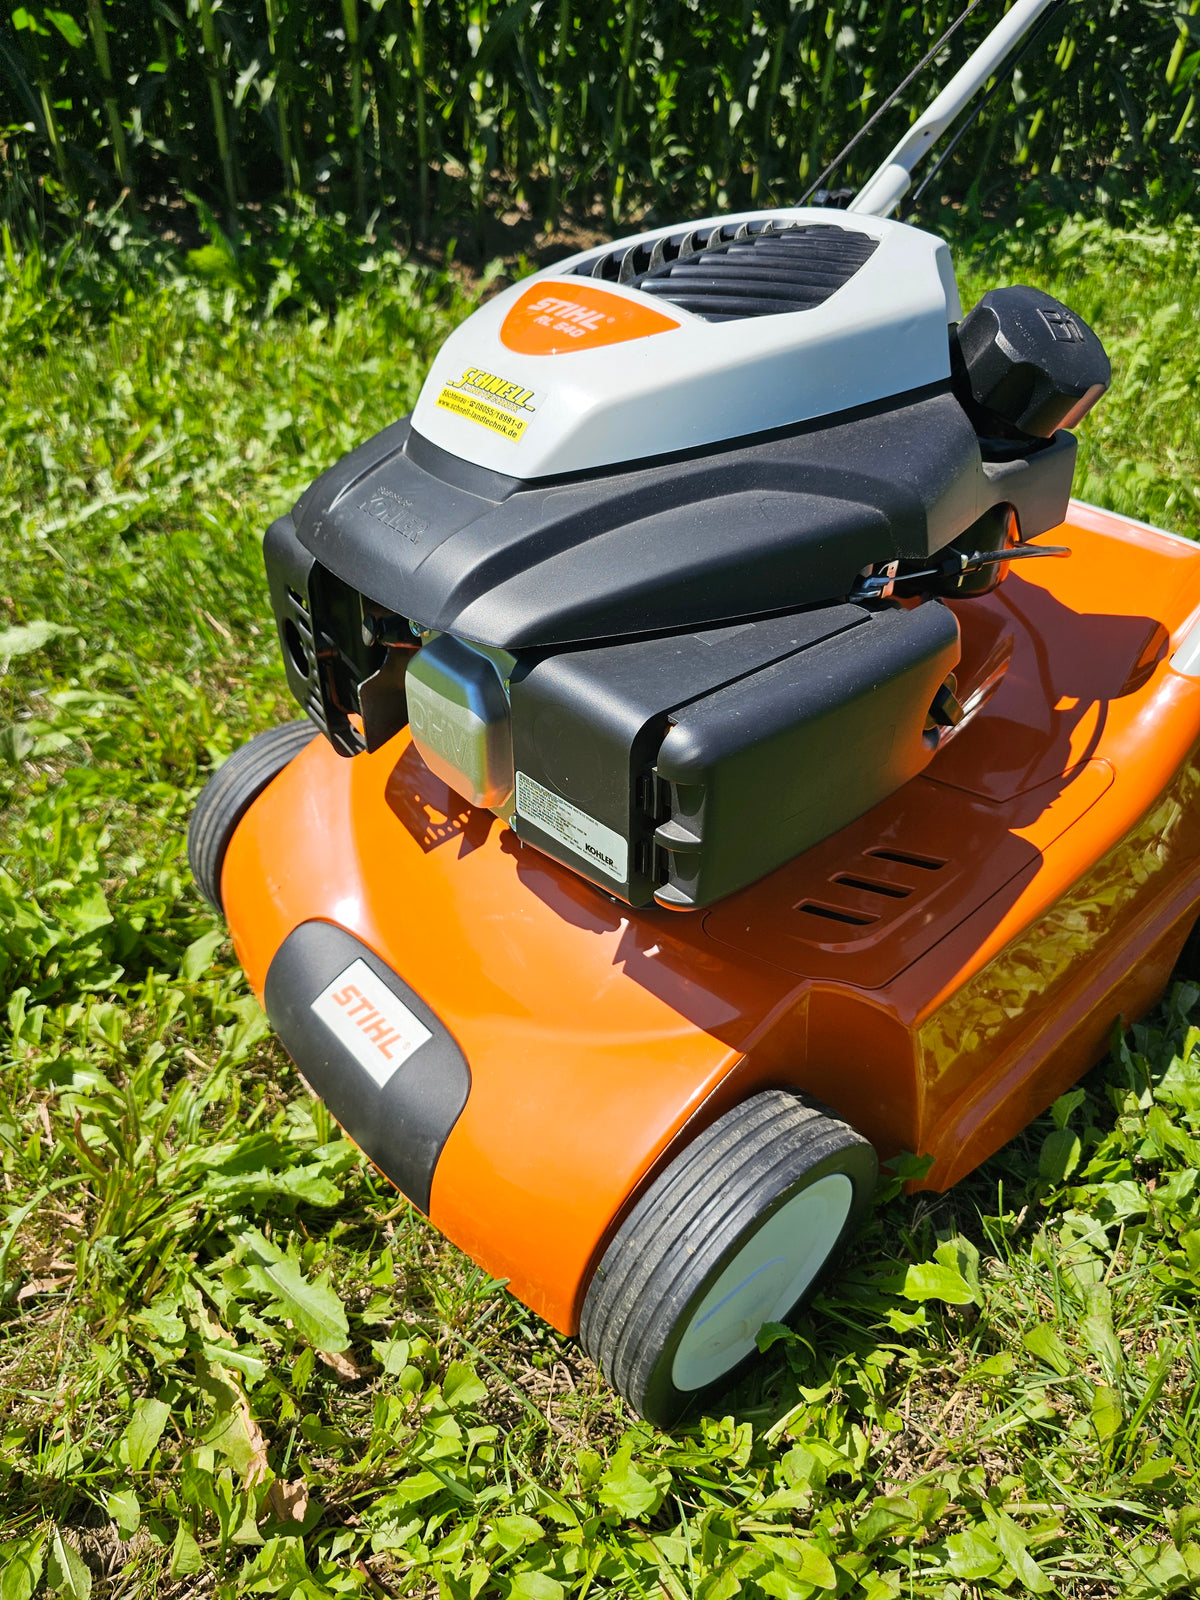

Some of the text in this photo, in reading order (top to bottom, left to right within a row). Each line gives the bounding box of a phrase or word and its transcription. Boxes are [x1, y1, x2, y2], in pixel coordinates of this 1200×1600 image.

[527, 296, 607, 331] STIHL
[533, 315, 586, 339] RL 540
[446, 366, 536, 412] SCHNELL
[437, 399, 518, 439] www.schnell-landtechnik.de
[585, 842, 614, 867] KOHLER
[331, 983, 402, 1060] STIHL
